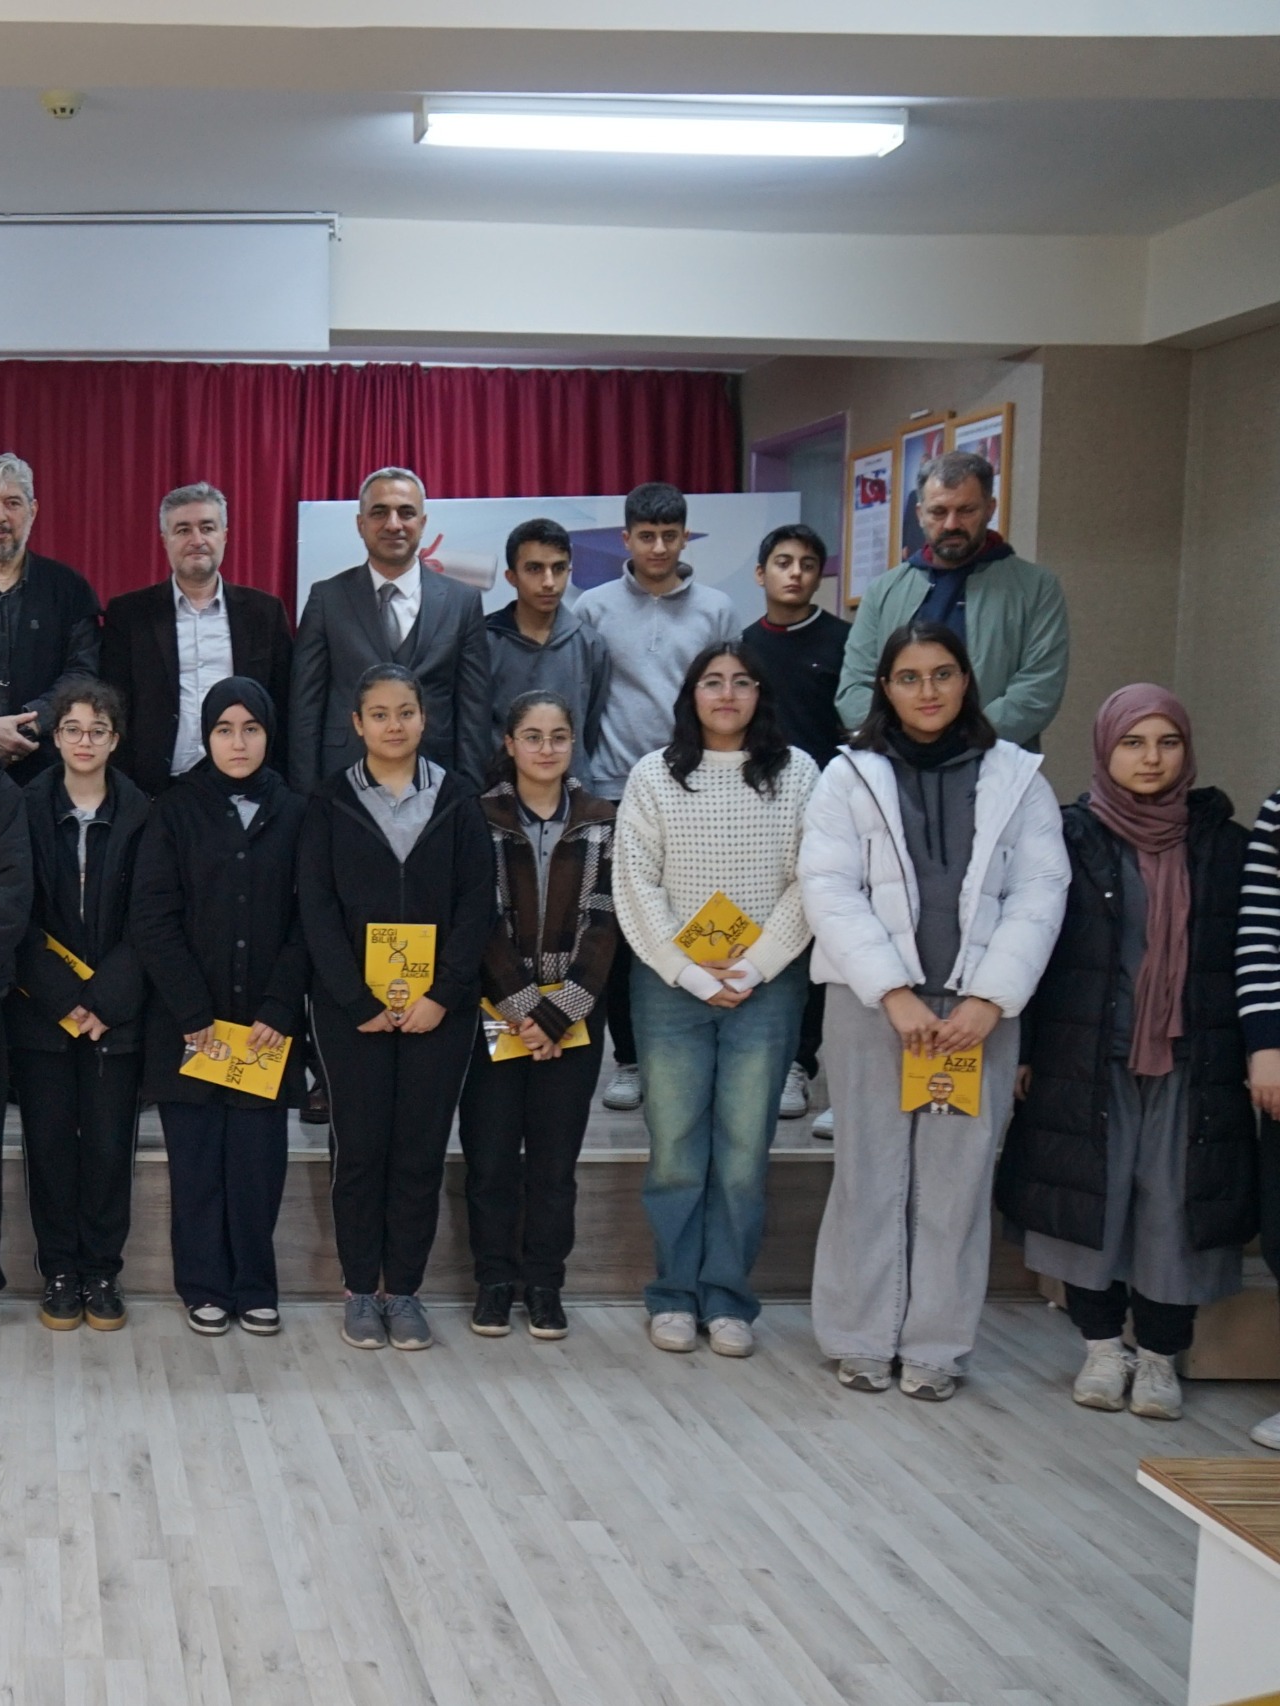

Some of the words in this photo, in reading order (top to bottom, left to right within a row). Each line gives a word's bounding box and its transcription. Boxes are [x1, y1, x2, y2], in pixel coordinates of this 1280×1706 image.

[401, 962, 430, 973] AZİZ
[944, 1054, 978, 1067] AZİZ
[231, 1058, 244, 1085] AZİZ
